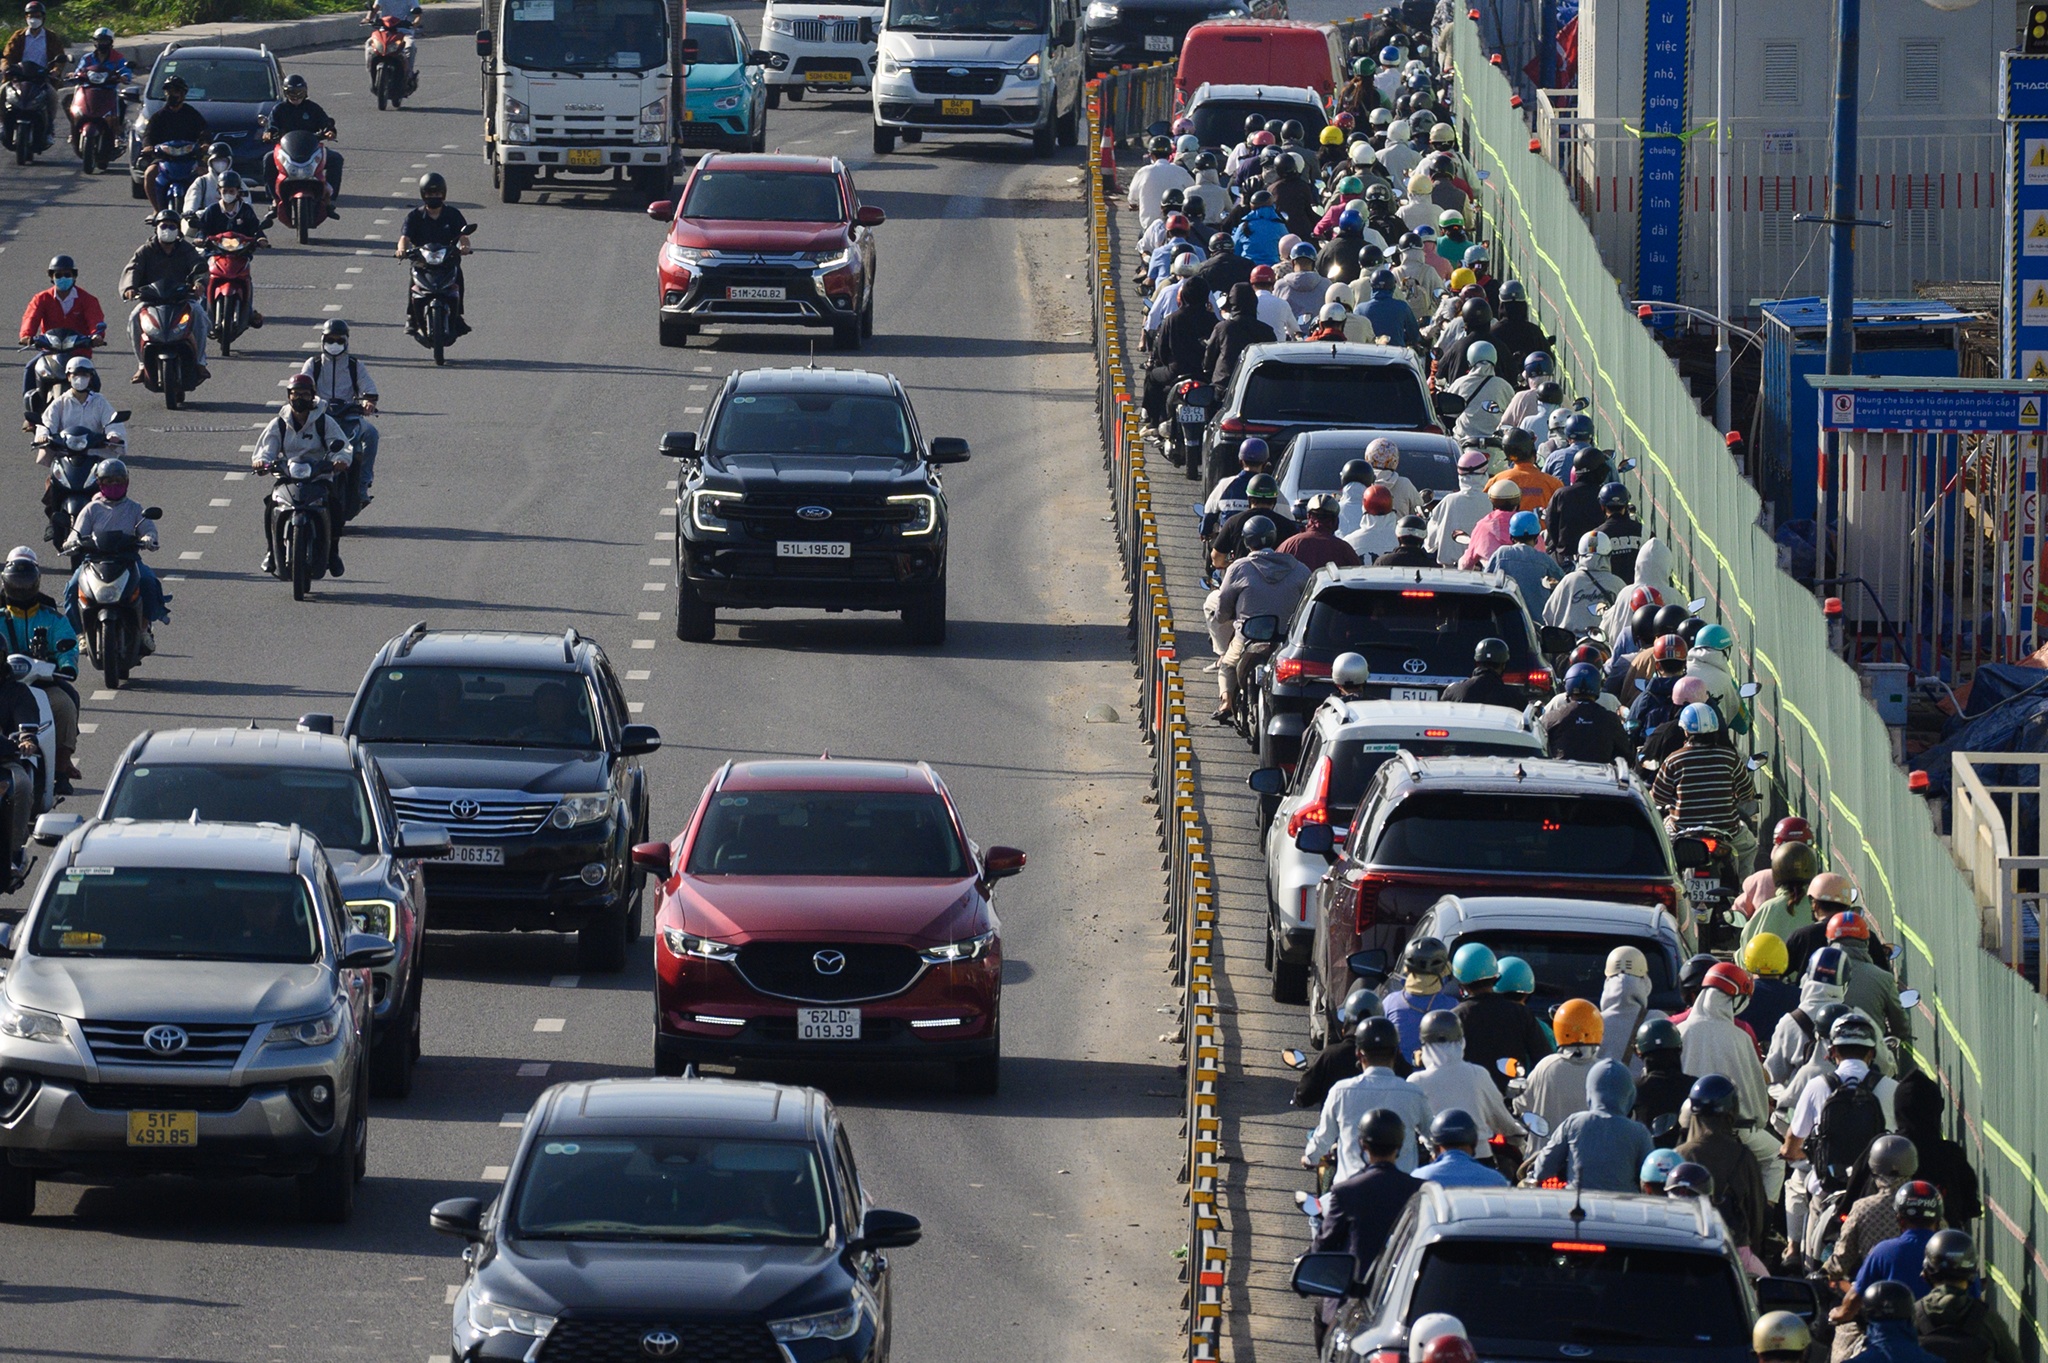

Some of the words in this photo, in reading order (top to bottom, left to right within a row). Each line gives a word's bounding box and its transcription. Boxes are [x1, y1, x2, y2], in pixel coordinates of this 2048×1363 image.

[1662, 12, 1674, 24] từ
[1655, 40, 1677, 54] việc
[1654, 67, 1677, 80] nhỏ,
[1649, 94, 1679, 109] gióng
[1649, 147, 1676, 156] chuông
[1649, 169, 1674, 181] cảnh
[1650, 196, 1671, 208] tỉnh
[1652, 224, 1668, 236] dài
[1649, 252, 1668, 263] lâu.
[732, 289, 781, 298] 51M-240.82
[1856, 396, 1882, 405] Khung
[1883, 396, 1898, 404] che
[1955, 397, 1975, 406] phân
[1976, 396, 1994, 406] phối
[1995, 396, 2010, 407] cấp
[1888, 408, 1930, 416] electrical
[1948, 410, 1993, 418] protection
[783, 544, 845, 555] 51L-195.02
[811, 1010, 847, 1023] 62LD
[804, 1025, 853, 1038] 019.39
[148, 1113, 177, 1128] 51F
[136, 1129, 189, 1144] 493.85
